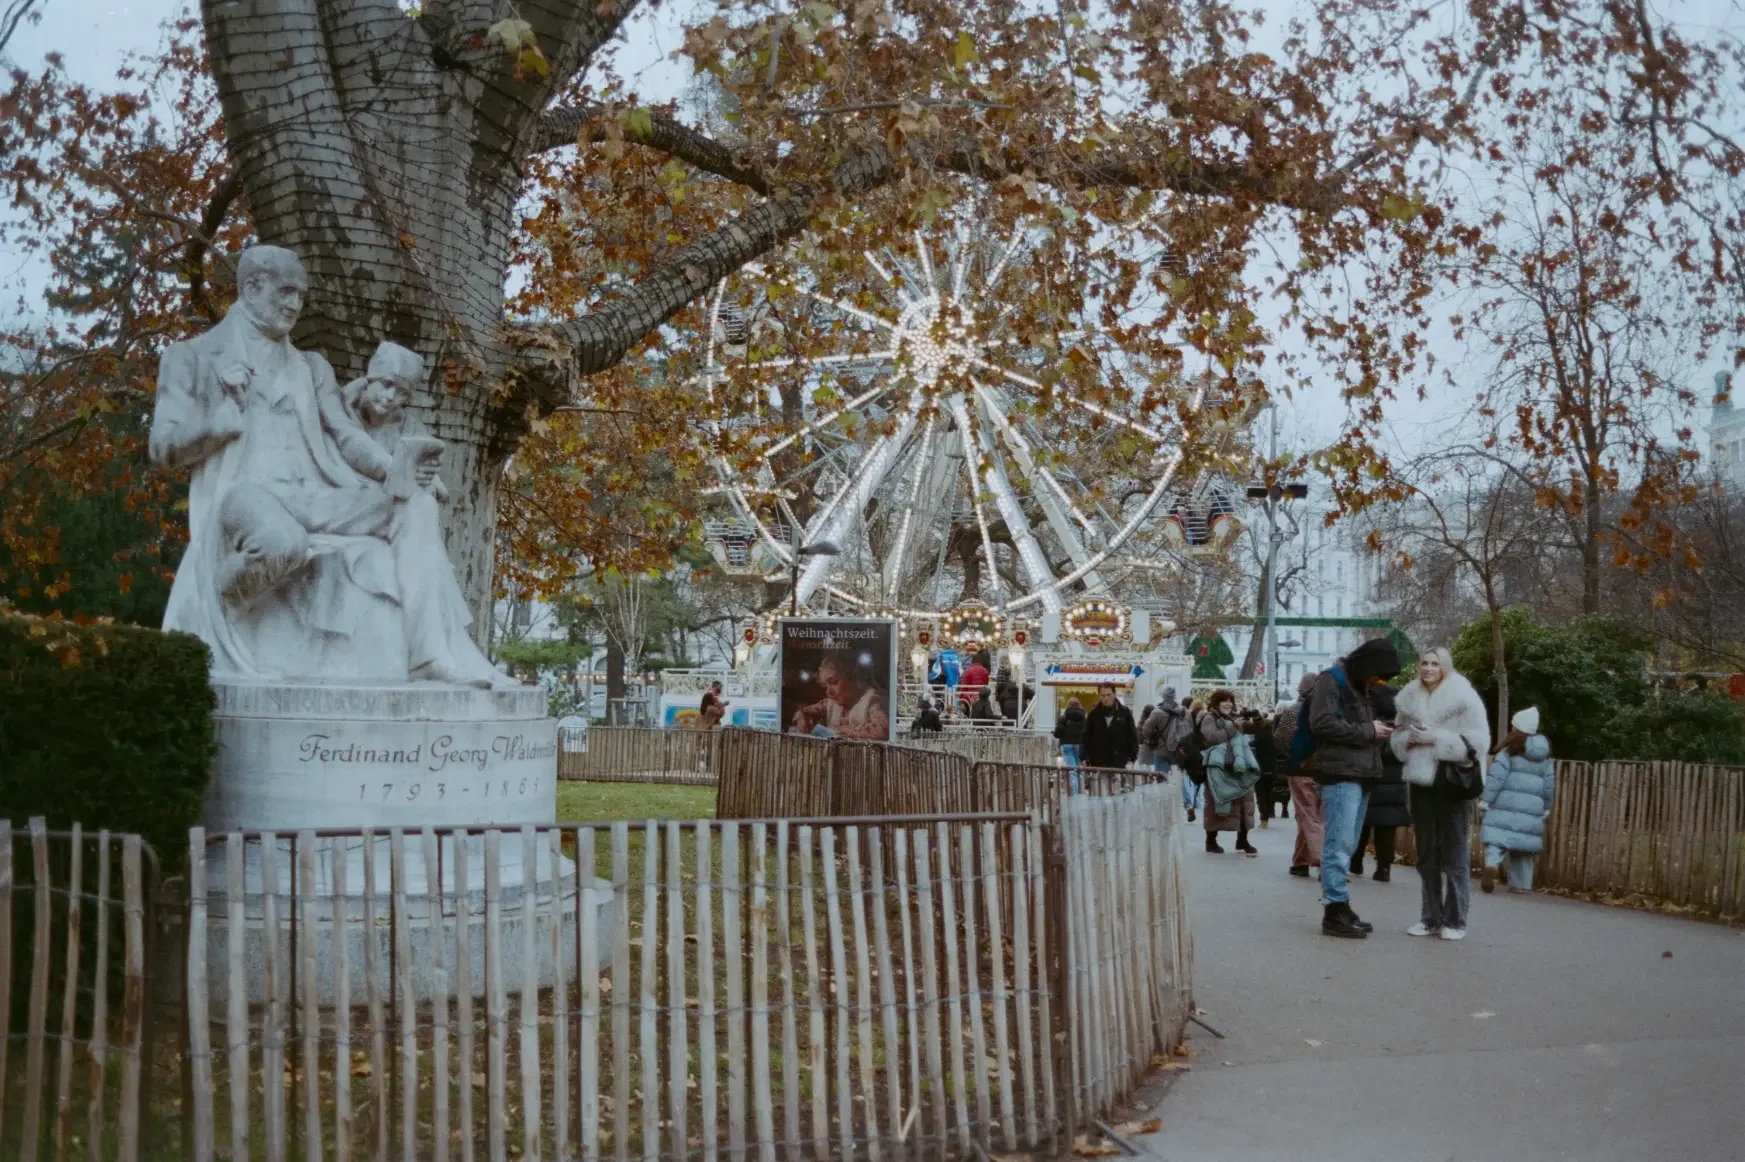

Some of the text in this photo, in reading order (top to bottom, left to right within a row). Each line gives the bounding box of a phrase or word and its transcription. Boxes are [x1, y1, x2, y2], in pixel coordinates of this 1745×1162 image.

[787, 627, 879, 639] Weihnachtszeit.
[299, 733, 421, 764] Ferdinand
[428, 734, 488, 772] Georg
